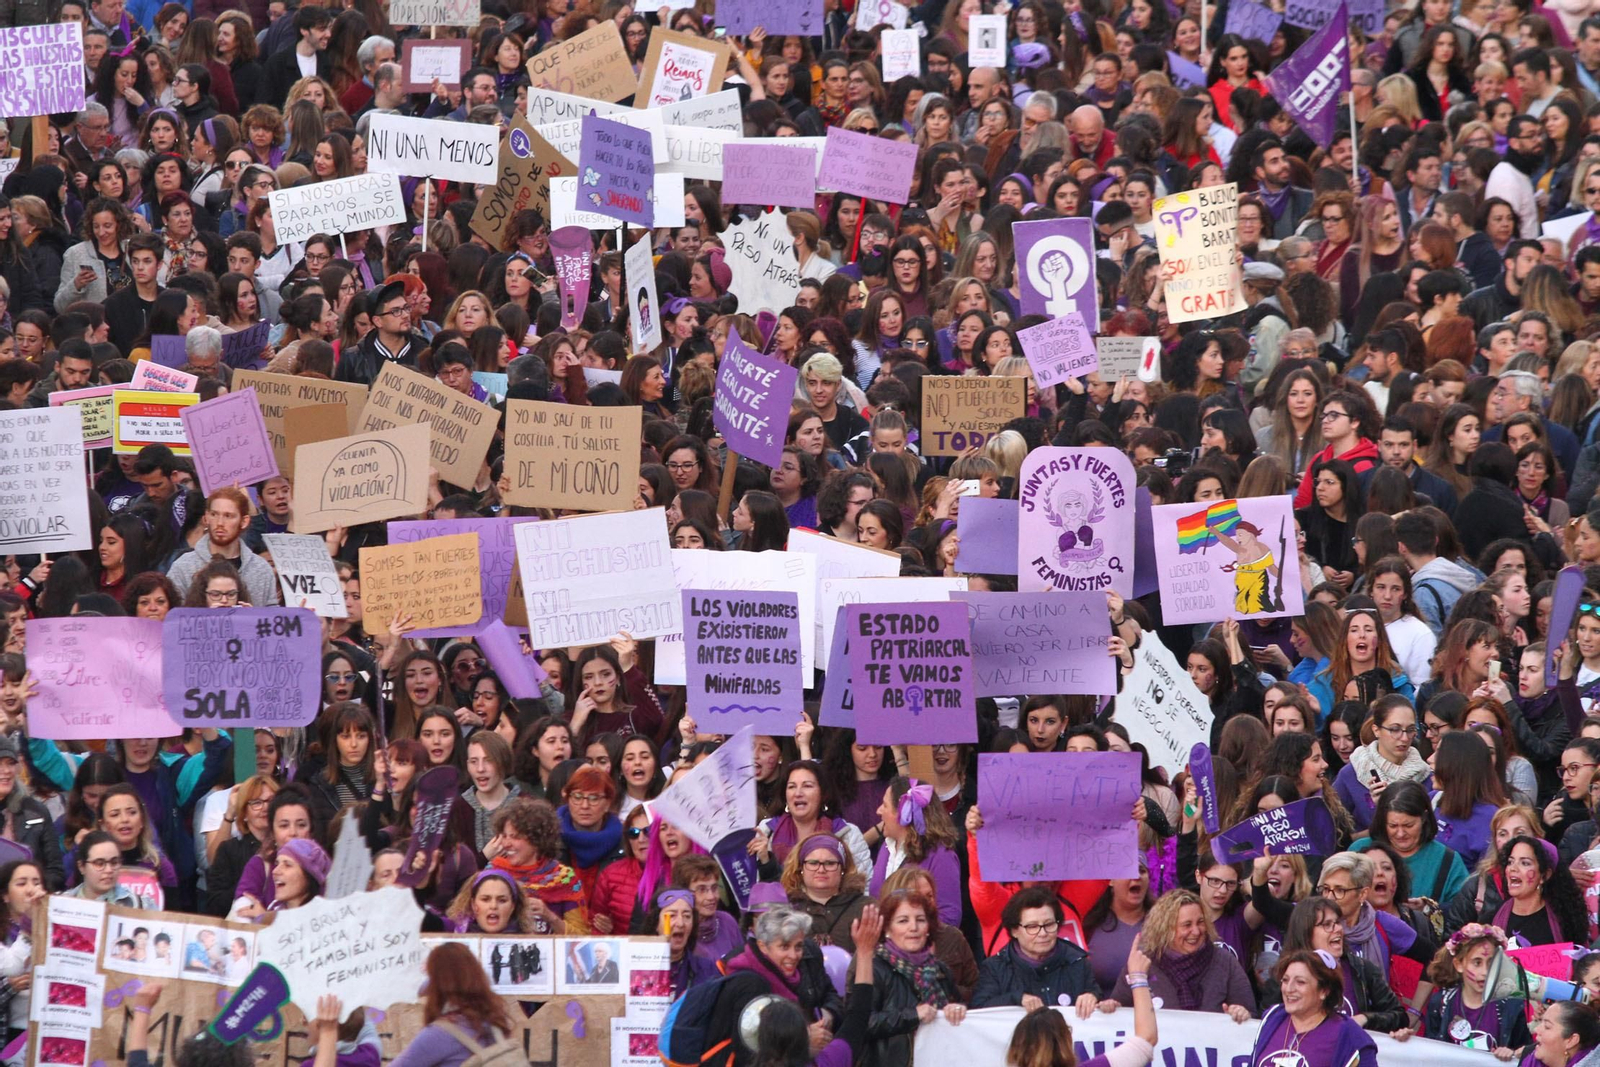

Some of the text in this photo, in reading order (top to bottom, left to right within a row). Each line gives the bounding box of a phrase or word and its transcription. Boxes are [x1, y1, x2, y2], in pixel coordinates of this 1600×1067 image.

[533, 32, 616, 75] QUE PARTE DEL
[34, 64, 82, 89] ESTÁN
[370, 128, 494, 167] NI UNA MENOS
[527, 162, 543, 182] DE
[275, 174, 392, 208] SI NOSOTRAS
[374, 190, 394, 205] SE
[483, 166, 521, 232] SOMOS
[1200, 206, 1238, 228] BONIT
[278, 223, 316, 242] PARA
[322, 217, 341, 230] EL
[1202, 227, 1238, 249] BARAT
[731, 230, 762, 264] PASO
[772, 237, 792, 256] UN
[1031, 335, 1082, 363] LIBRES
[730, 346, 781, 389] LIBERTÉ
[1037, 353, 1098, 384] NO VALIENTES
[239, 377, 349, 405] NOSOTRAS MOVEMOS
[721, 367, 769, 411] EGALITÉ
[928, 379, 951, 390] NOS
[372, 389, 393, 409] QUE
[381, 371, 484, 427] NOS QUITARON TANTO
[32, 414, 51, 426] UNA
[514, 409, 613, 430] YO NO SALÍ DE TU
[714, 388, 769, 440] SORORITÉ
[26, 429, 48, 443] QUE
[948, 421, 956, 431] Y
[12, 443, 83, 460] A LAS MUJERES
[564, 432, 578, 450] TÚ
[24, 460, 73, 474] DE NO SER
[332, 460, 380, 478] YA COMO
[518, 460, 536, 489] DE
[573, 456, 621, 497] COÑO
[24, 477, 62, 490] EN VEZ
[1019, 453, 1126, 513] JUNTAS Y FUERTES
[30, 492, 61, 504] A LOS
[36, 506, 45, 517] A
[12, 515, 70, 537] VIOLAR
[522, 522, 572, 551] NI
[413, 551, 432, 564] TAN
[435, 547, 475, 565] FUERTES
[525, 539, 663, 582] MICHISMI
[365, 569, 425, 591] QUE HEMOS
[1031, 555, 1112, 592] FEMINISTAS
[1168, 559, 1211, 579] LIBERTAD
[281, 573, 322, 595] VOZ
[532, 588, 571, 616] NI
[690, 595, 722, 619] LOS
[1080, 602, 1092, 616] A
[255, 614, 304, 639] #8M
[859, 612, 940, 637] ESTADO
[1004, 623, 1055, 638] CASA
[696, 643, 799, 666] ANTES QUE LAS
[1031, 637, 1062, 652] SER
[1018, 655, 1038, 668] NO
[183, 660, 304, 689] HOY NO VOY
[864, 663, 964, 685] TE VAMOS
[977, 667, 1088, 689] VALIENTE
[183, 687, 252, 720] SOLA
[1146, 680, 1179, 721] NO SE
[1174, 690, 1209, 732] DERECHOS
[1270, 806, 1289, 822] UN
[1259, 819, 1292, 837] PASO
[278, 923, 305, 951] SOY
[359, 919, 370, 938] Y
[382, 930, 412, 950] SOY
